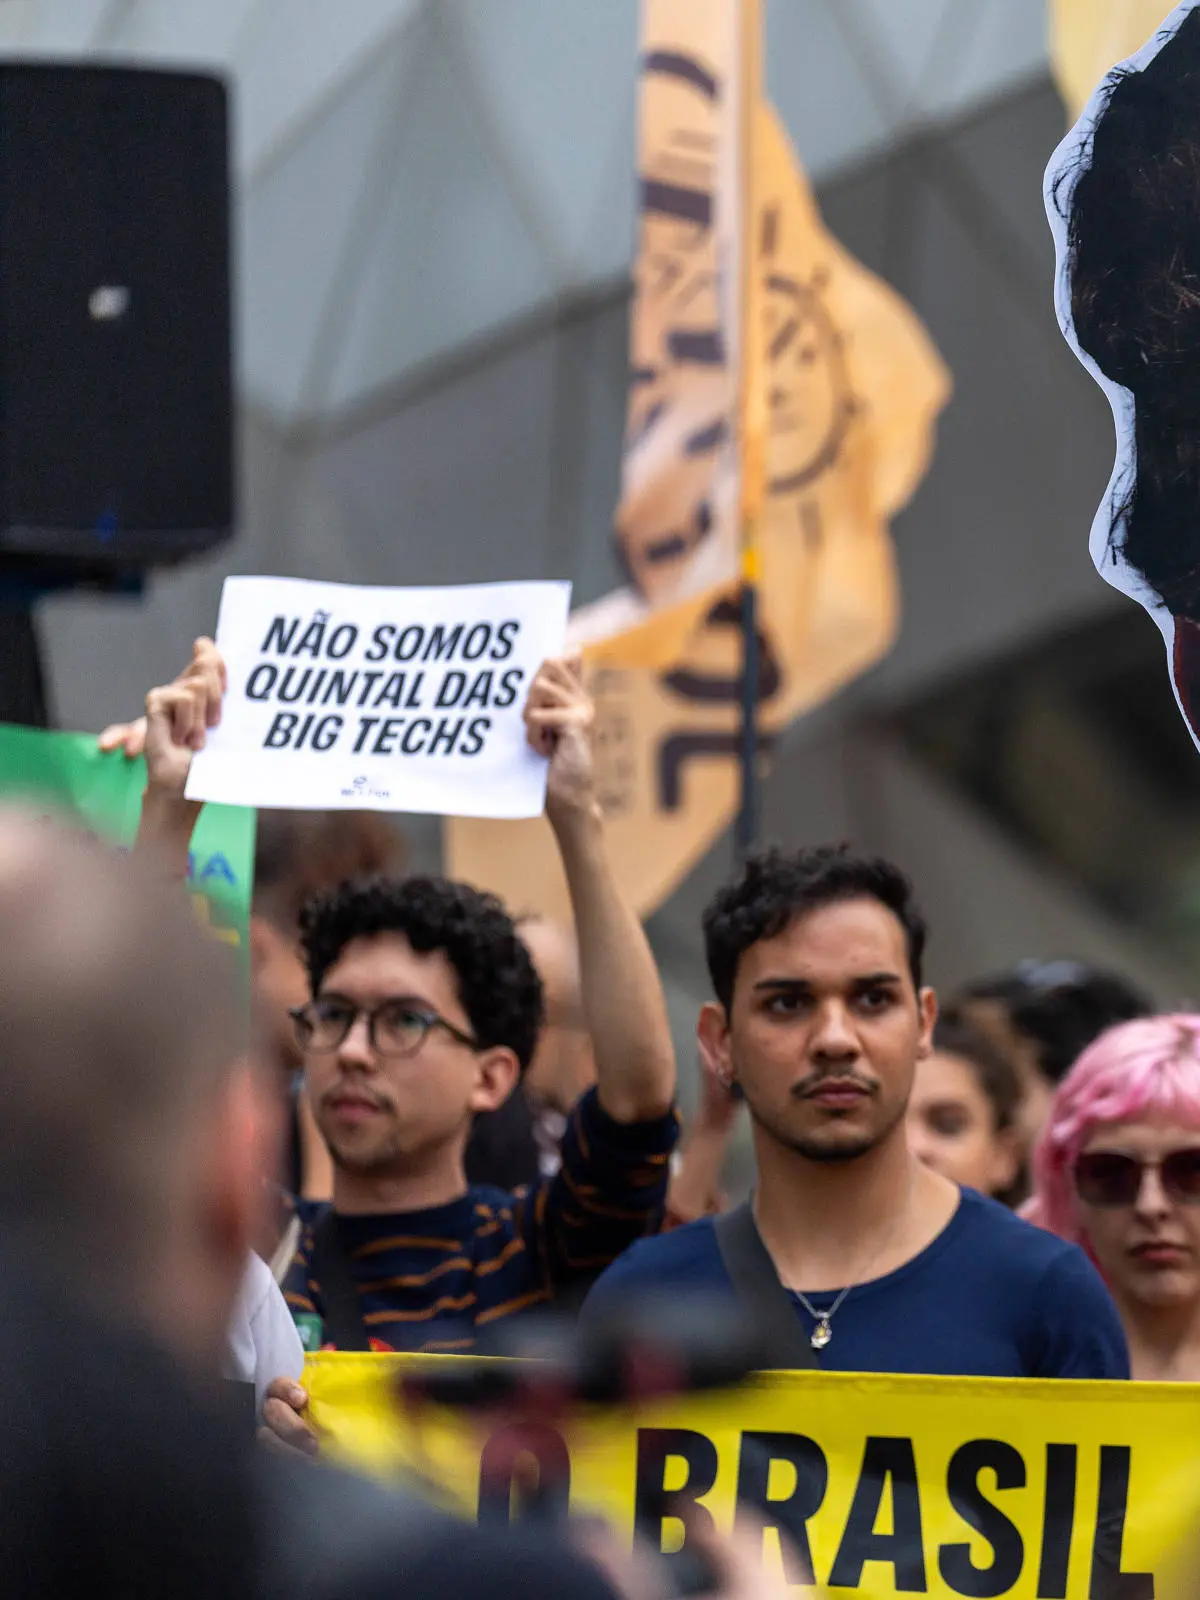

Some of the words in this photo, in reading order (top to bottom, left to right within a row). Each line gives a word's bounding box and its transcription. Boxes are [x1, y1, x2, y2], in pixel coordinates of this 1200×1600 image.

[260, 610, 359, 661] NÃO
[364, 620, 520, 662] SOMOS
[245, 663, 425, 709] QUINTAL
[433, 669, 524, 709] DAS
[262, 711, 344, 752] BIG
[351, 716, 492, 756] TECHS
[632, 1428, 1154, 1599] BRASIL
